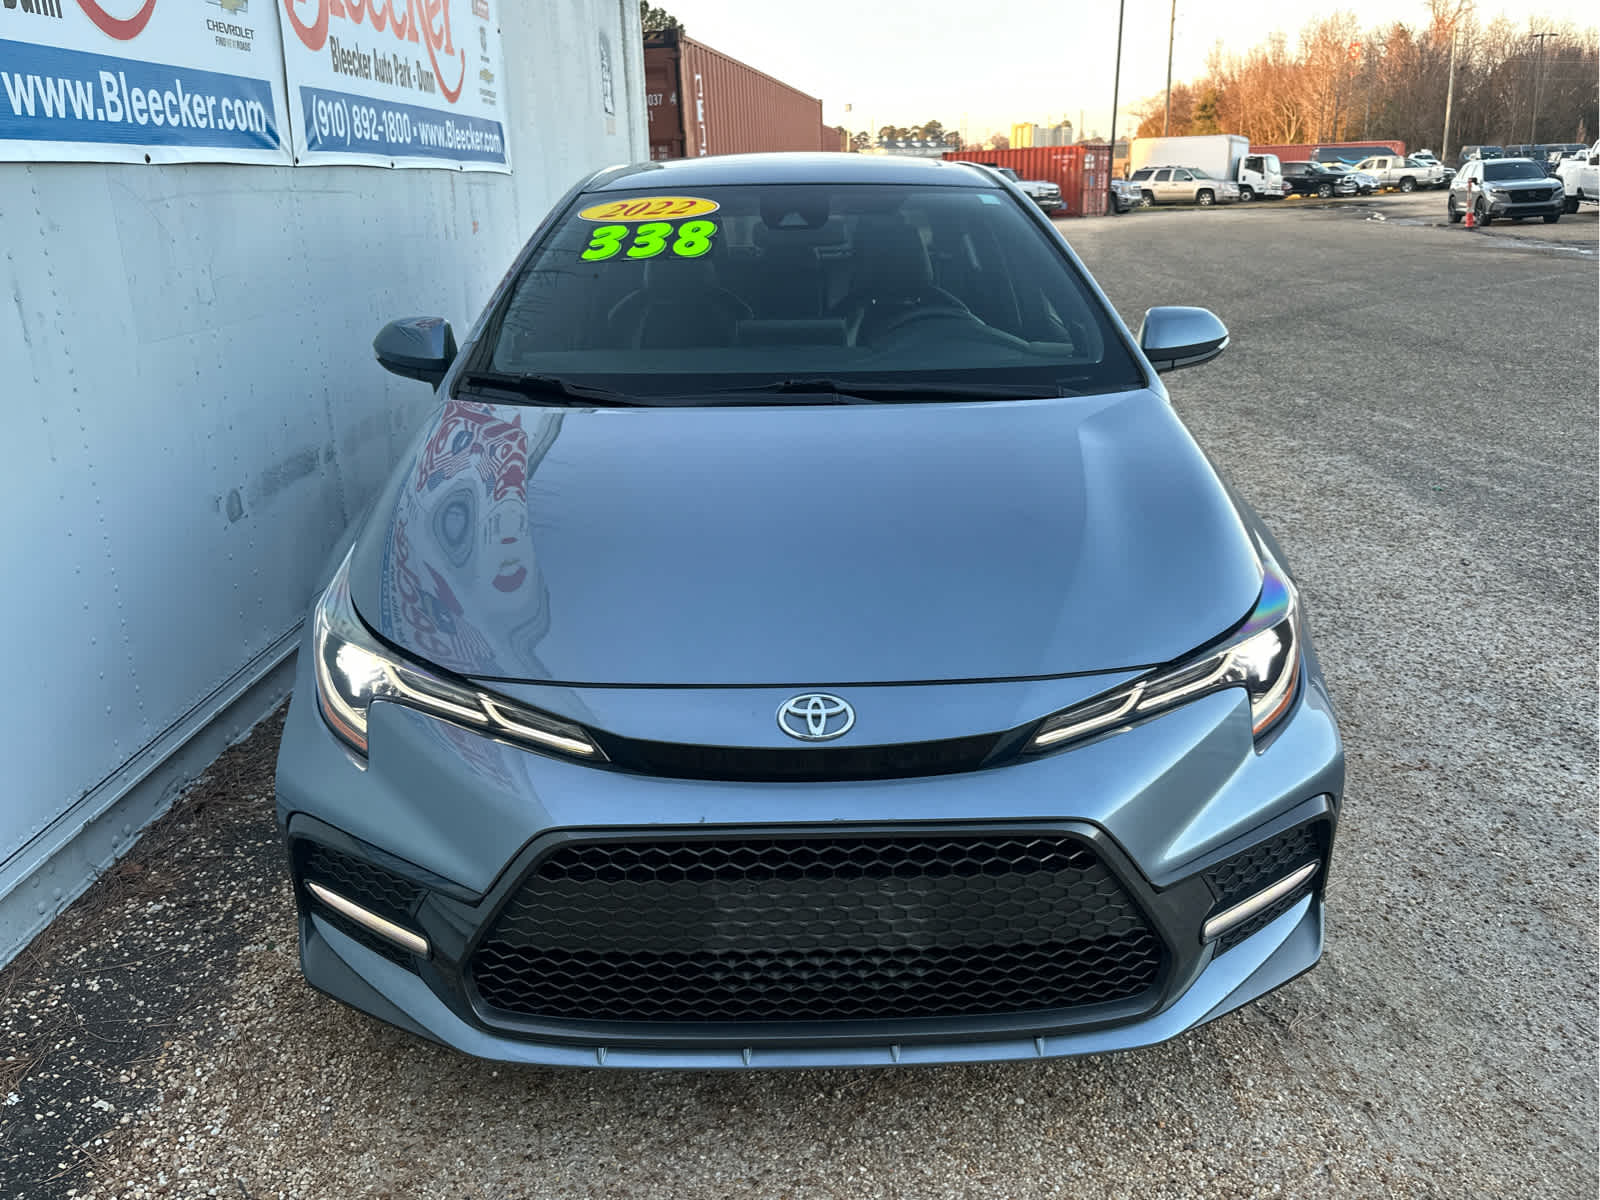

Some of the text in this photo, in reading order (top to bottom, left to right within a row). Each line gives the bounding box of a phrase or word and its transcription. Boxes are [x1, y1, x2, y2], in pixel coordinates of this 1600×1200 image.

[206, 19, 254, 40] CHEVROLET
[329, 35, 373, 80] Bleecker
[373, 48, 393, 85] Auto
[393, 53, 413, 88] Park
[416, 60, 436, 94] Dunn
[0, 70, 266, 133] www.Bleecker.com
[312, 94, 502, 153] (910) 892-1800 www.Bleecker.com
[599, 200, 697, 218] 2022
[581, 220, 717, 261] 338
